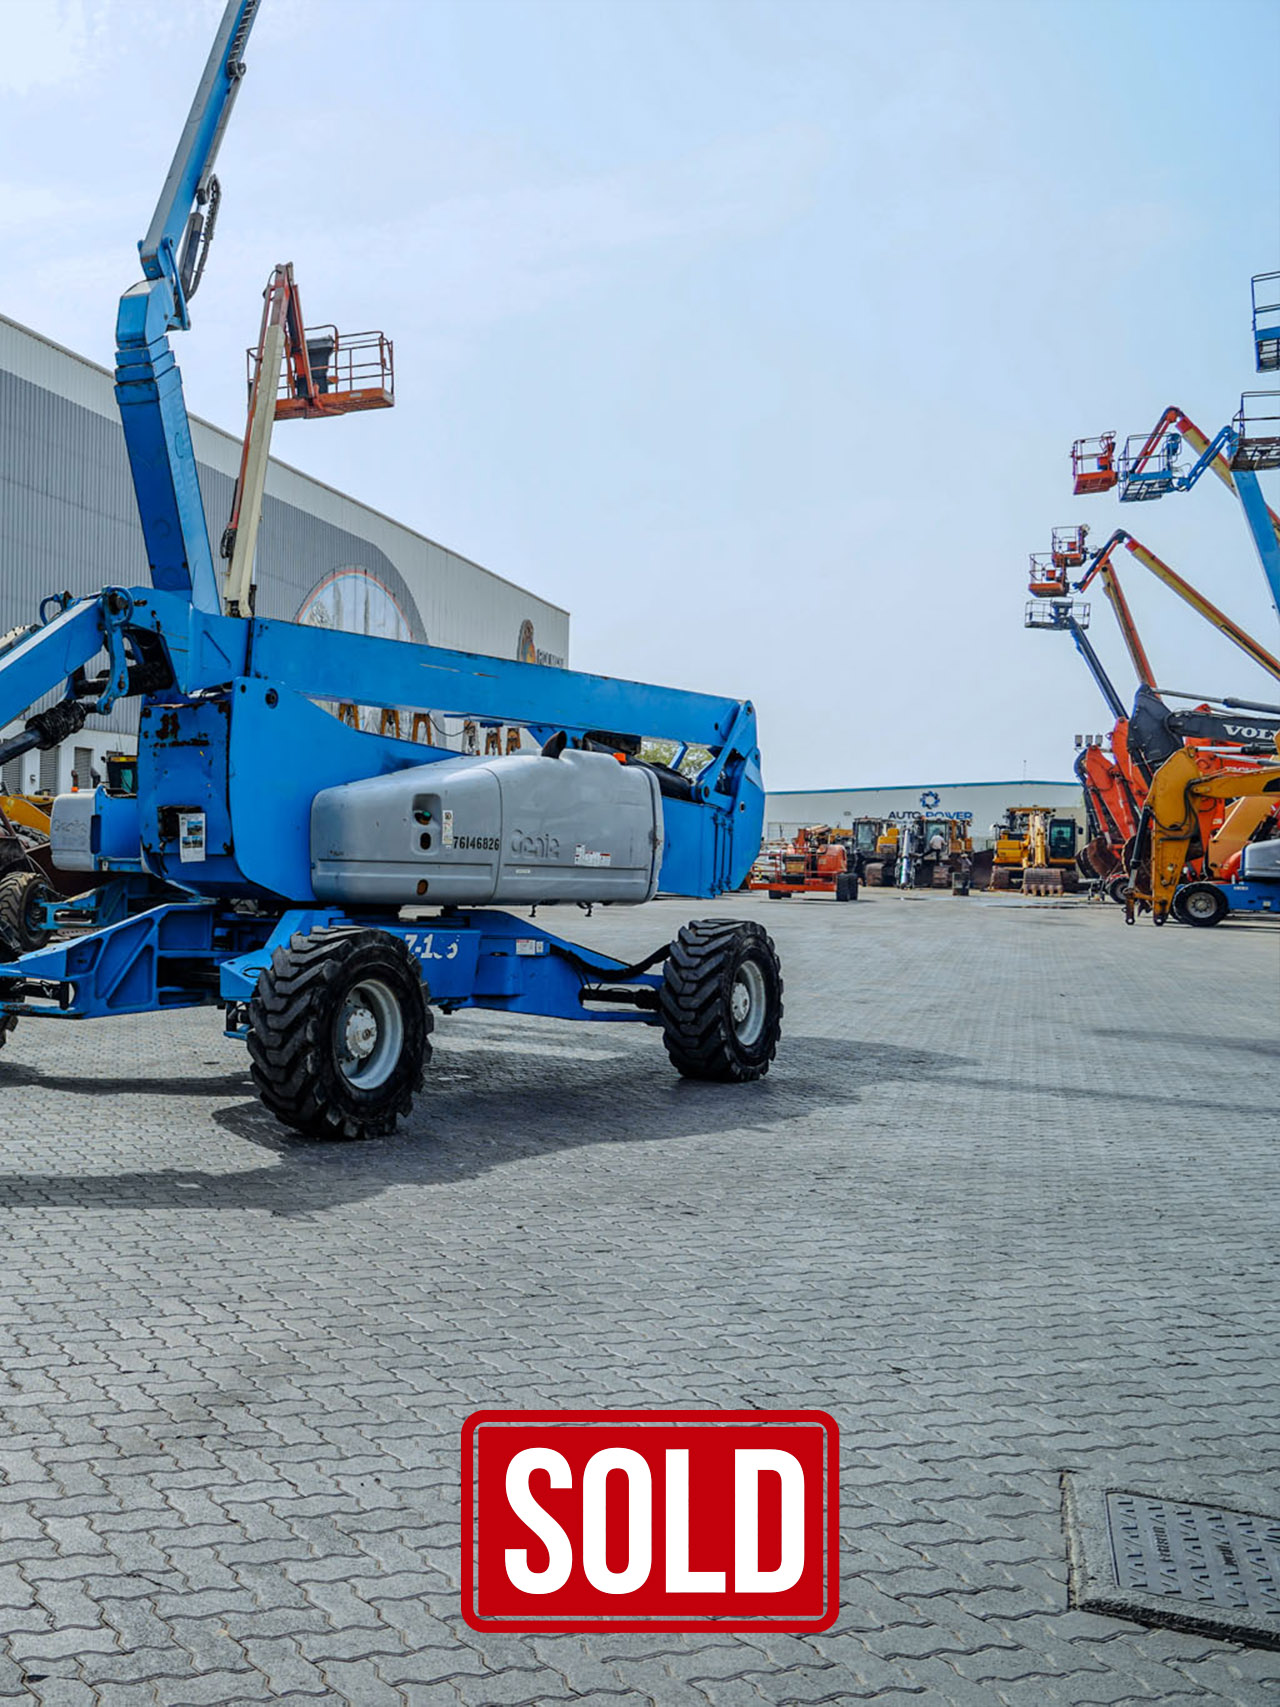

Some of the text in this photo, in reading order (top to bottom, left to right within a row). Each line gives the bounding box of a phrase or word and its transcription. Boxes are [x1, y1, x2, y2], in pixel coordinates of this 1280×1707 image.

[888, 811, 974, 821] AUTO POWER
[452, 836, 500, 851] 76146826
[511, 828, 560, 858] Genie
